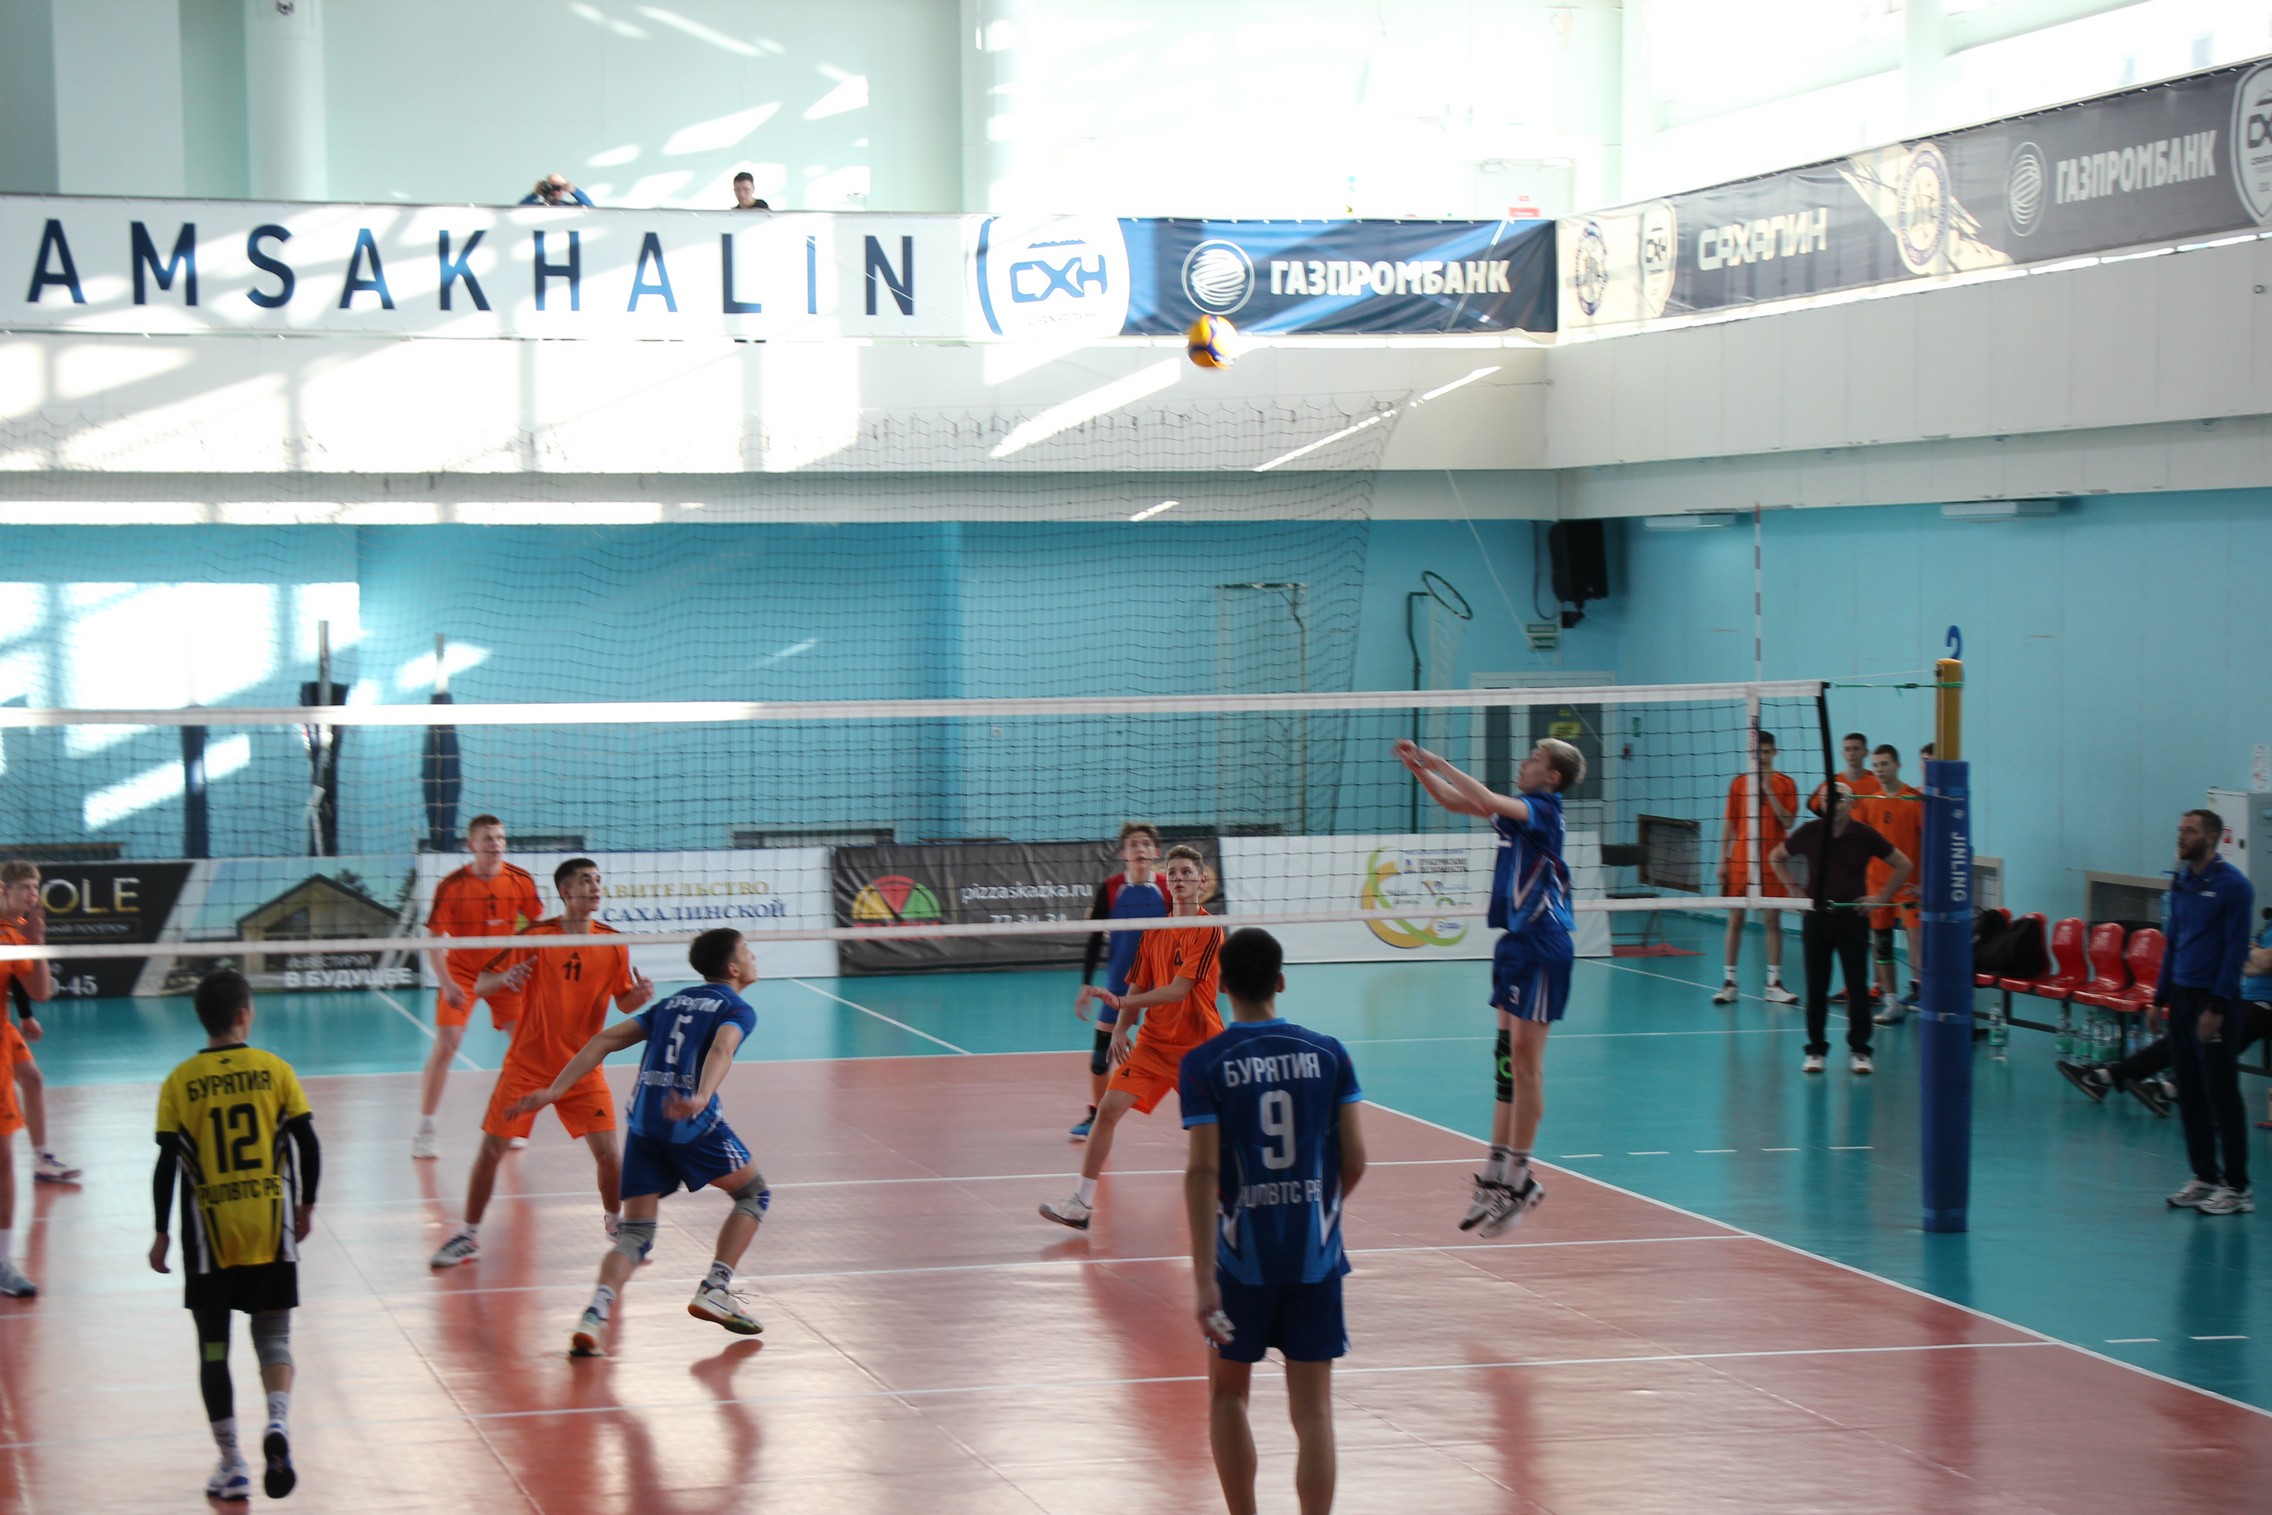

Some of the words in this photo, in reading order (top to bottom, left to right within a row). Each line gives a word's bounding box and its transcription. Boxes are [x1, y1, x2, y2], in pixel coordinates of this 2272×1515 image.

[2056, 130, 2217, 204] ГАЗПРОМБАНК
[1698, 207, 1828, 272] САХАЛИН
[1270, 260, 1512, 297] ГАЗПРОМБАНК
[1950, 832, 1967, 902] JINLING
[40, 877, 140, 914] OLE
[536, 880, 770, 901] ПАВИТЕЛЬСТВО
[603, 898, 788, 923] САХАЛИНСКОЙ
[563, 960, 582, 982] 11
[1508, 985, 1520, 1005] 3
[664, 1014, 694, 1065] 5
[186, 1070, 272, 1102] БУРЯТИЯ
[1224, 1052, 1321, 1088] БУРЯТИЯ
[209, 1103, 263, 1174] 12
[1260, 1089, 1296, 1170] 9
